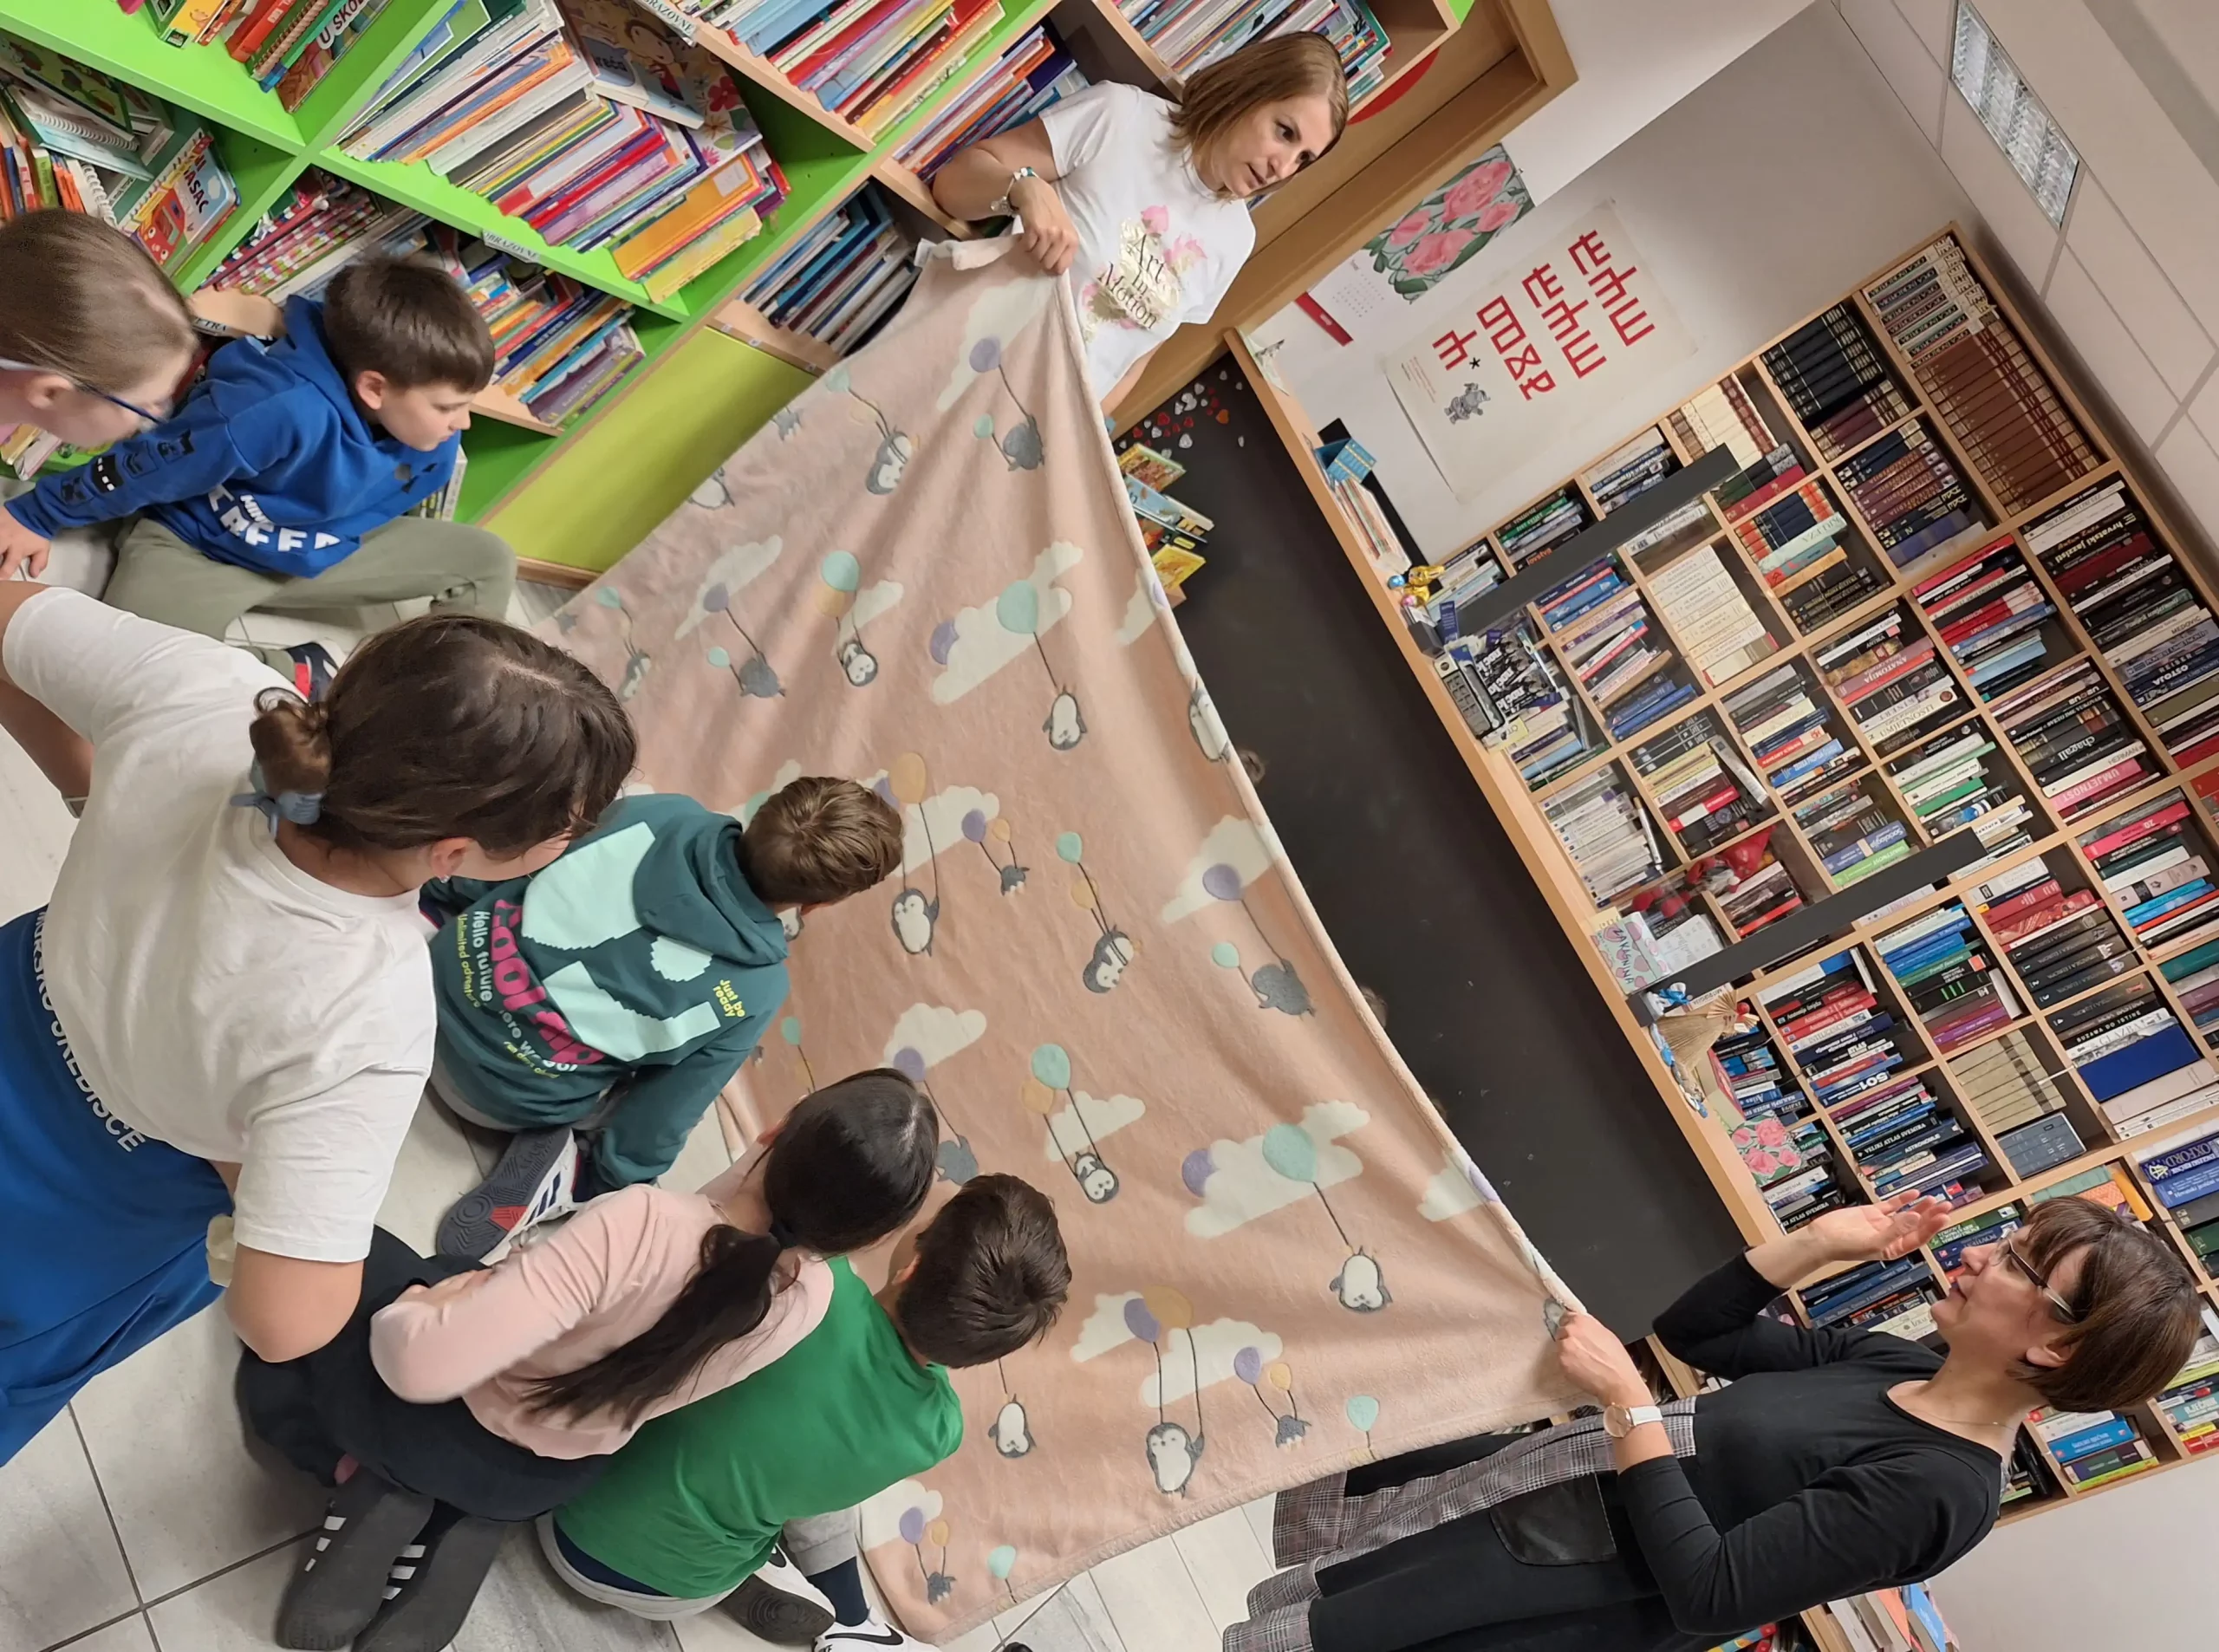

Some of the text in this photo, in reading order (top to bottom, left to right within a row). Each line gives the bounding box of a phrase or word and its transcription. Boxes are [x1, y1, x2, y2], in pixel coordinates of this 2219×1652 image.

[1127, 233, 1166, 284] Art
[1096, 261, 1158, 330] Motion
[2053, 520, 2124, 563] hrvatski jazzisti
[1862, 654, 1908, 684] ANATOMIJA
[2151, 662, 2190, 686] OSTOJA
[1878, 702, 1935, 737] UMJETNOSTI
[2060, 766, 2119, 803] UMJETNOST
[457, 914, 469, 959] Unlimited
[472, 910, 493, 1003] Hello future
[1858, 1070, 1889, 1090] 501
[1864, 1122, 1927, 1155] VELIKI ATLAS SVEMIRA
[2163, 1141, 2212, 1168] OXFORD
[1788, 1200, 1830, 1225] ATLAS SVEMIRA
